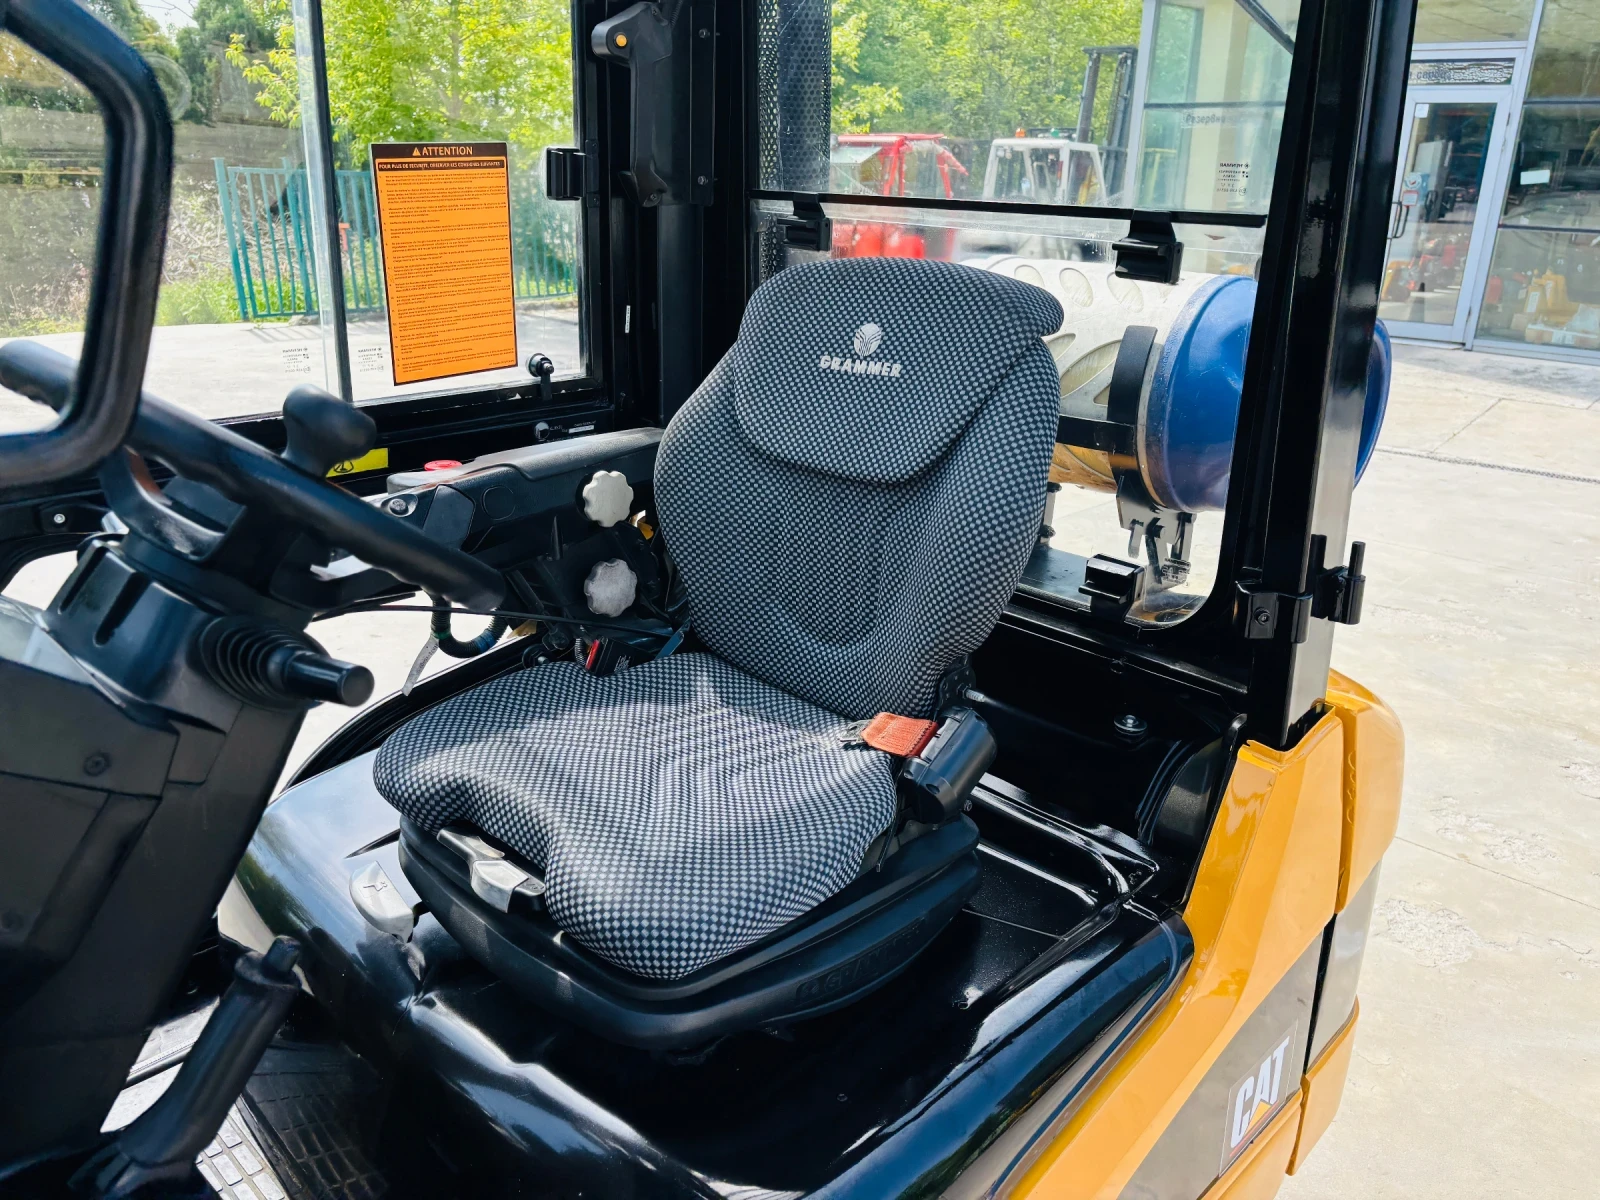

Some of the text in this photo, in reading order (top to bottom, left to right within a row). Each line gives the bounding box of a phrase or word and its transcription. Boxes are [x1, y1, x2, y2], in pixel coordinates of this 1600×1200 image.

[422, 146, 473, 156] ATTENTION
[820, 355, 902, 377] GRAMMER
[1231, 1036, 1290, 1149] CAT
